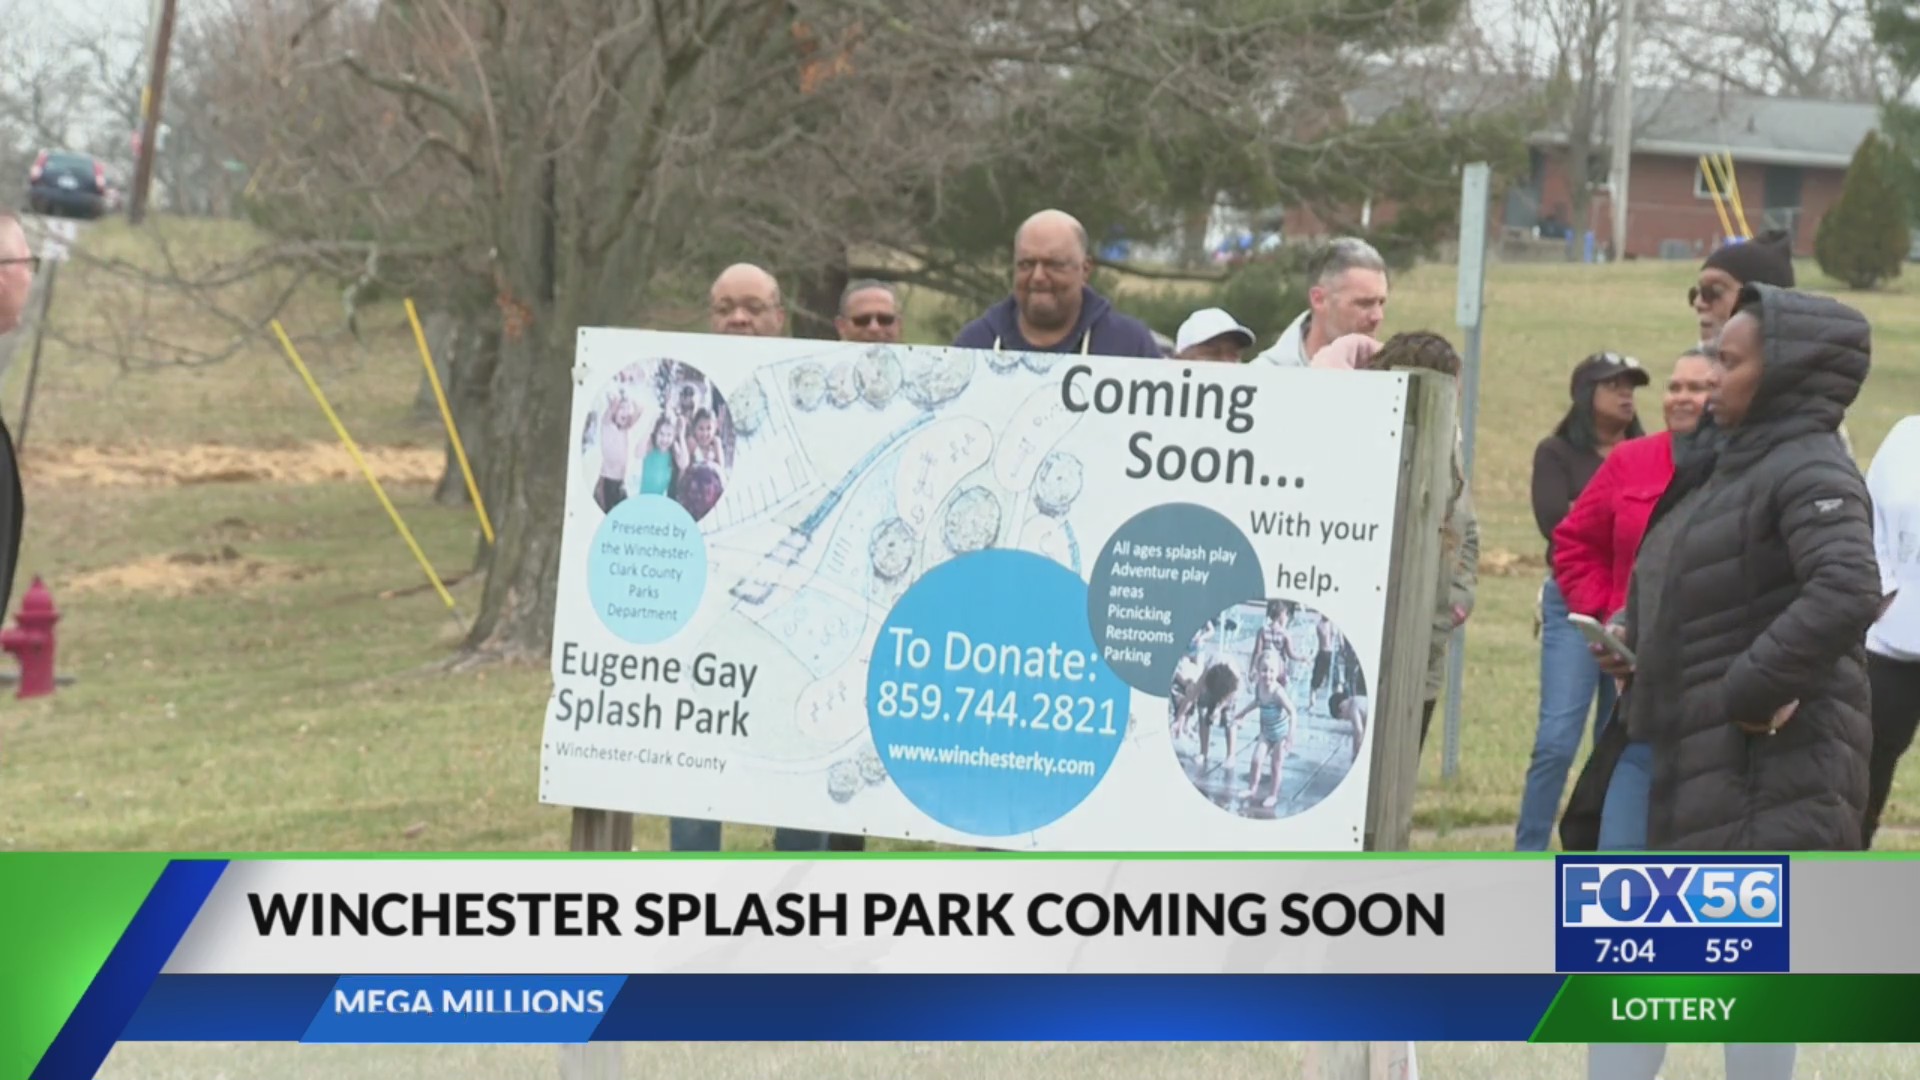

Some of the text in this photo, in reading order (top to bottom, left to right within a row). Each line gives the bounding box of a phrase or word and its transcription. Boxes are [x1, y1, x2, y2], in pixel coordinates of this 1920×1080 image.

[1061, 365, 1258, 433] Coming
[1125, 431, 1305, 488] Soon...
[611, 520, 687, 540] Presented by
[1251, 510, 1379, 545] With your
[601, 541, 694, 560] the Winchester-
[1112, 540, 1238, 566] All ages splash play
[609, 562, 683, 582] Clark County
[1110, 561, 1210, 585] Adventure play
[1276, 563, 1340, 597] help.
[628, 584, 659, 599] Parks
[1109, 584, 1144, 599] areas
[607, 602, 678, 621] Department
[1107, 603, 1172, 626] Picnicking
[1105, 624, 1175, 645] Restrooms
[889, 626, 1098, 683] To Donate:
[1103, 645, 1152, 667] Parking
[561, 641, 758, 698] Eugene Gay
[555, 688, 750, 738] Splash Park
[876, 680, 1117, 736] 859.744.2821
[555, 741, 727, 773] Winchester-Clark County
[888, 742, 1096, 777] www.winchesterky.com
